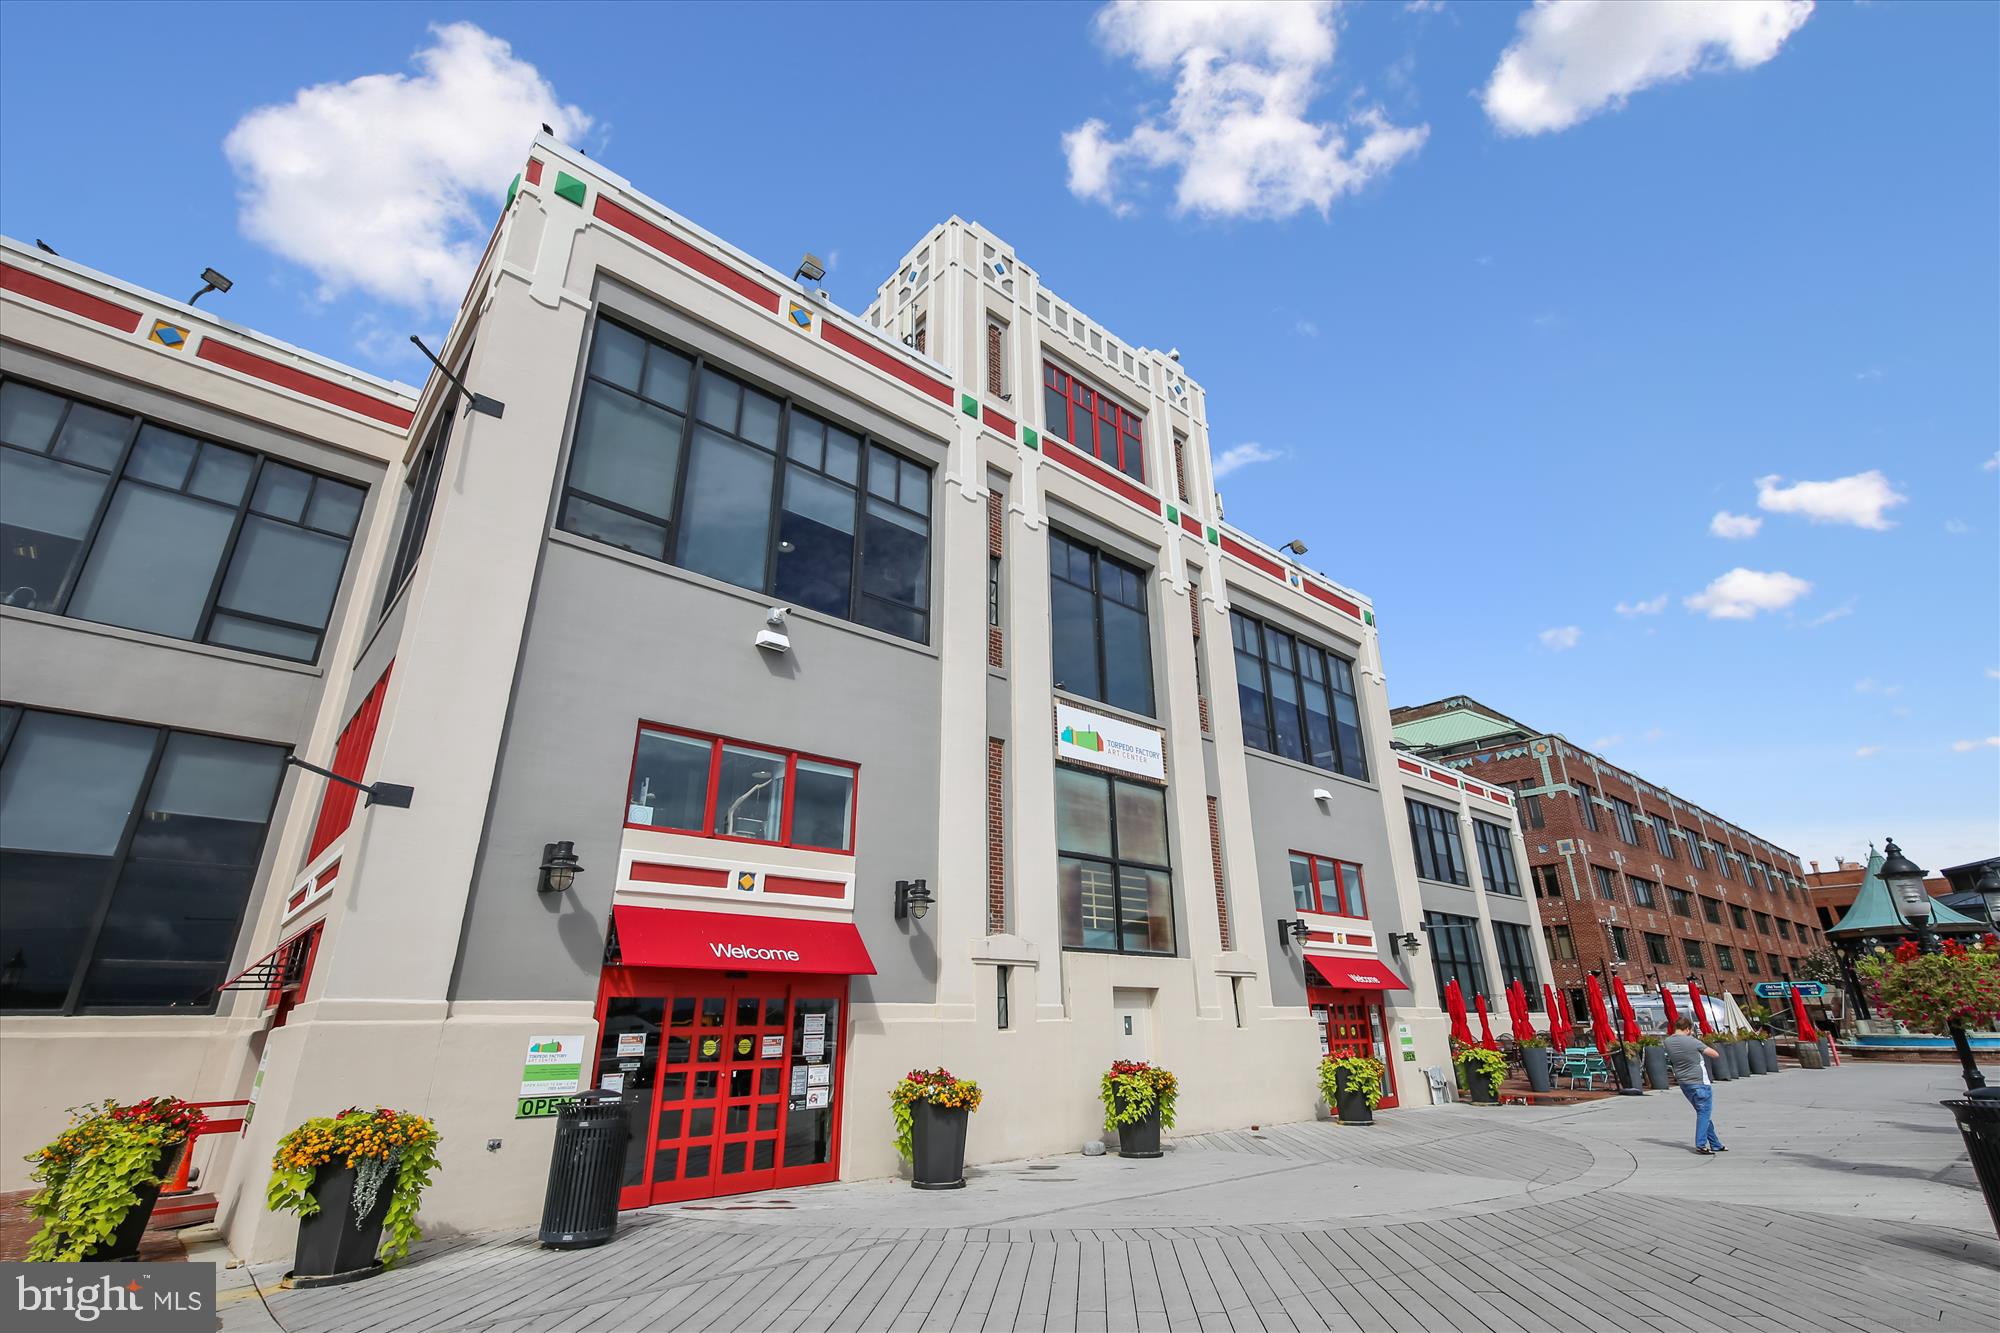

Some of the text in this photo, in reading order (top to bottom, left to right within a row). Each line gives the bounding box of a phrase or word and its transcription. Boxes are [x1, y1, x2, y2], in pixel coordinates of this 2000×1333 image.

[1107, 740, 1160, 760] TORPEDO FACTORY
[1107, 748, 1148, 763] ART CENTER
[709, 942, 800, 961] Welcome
